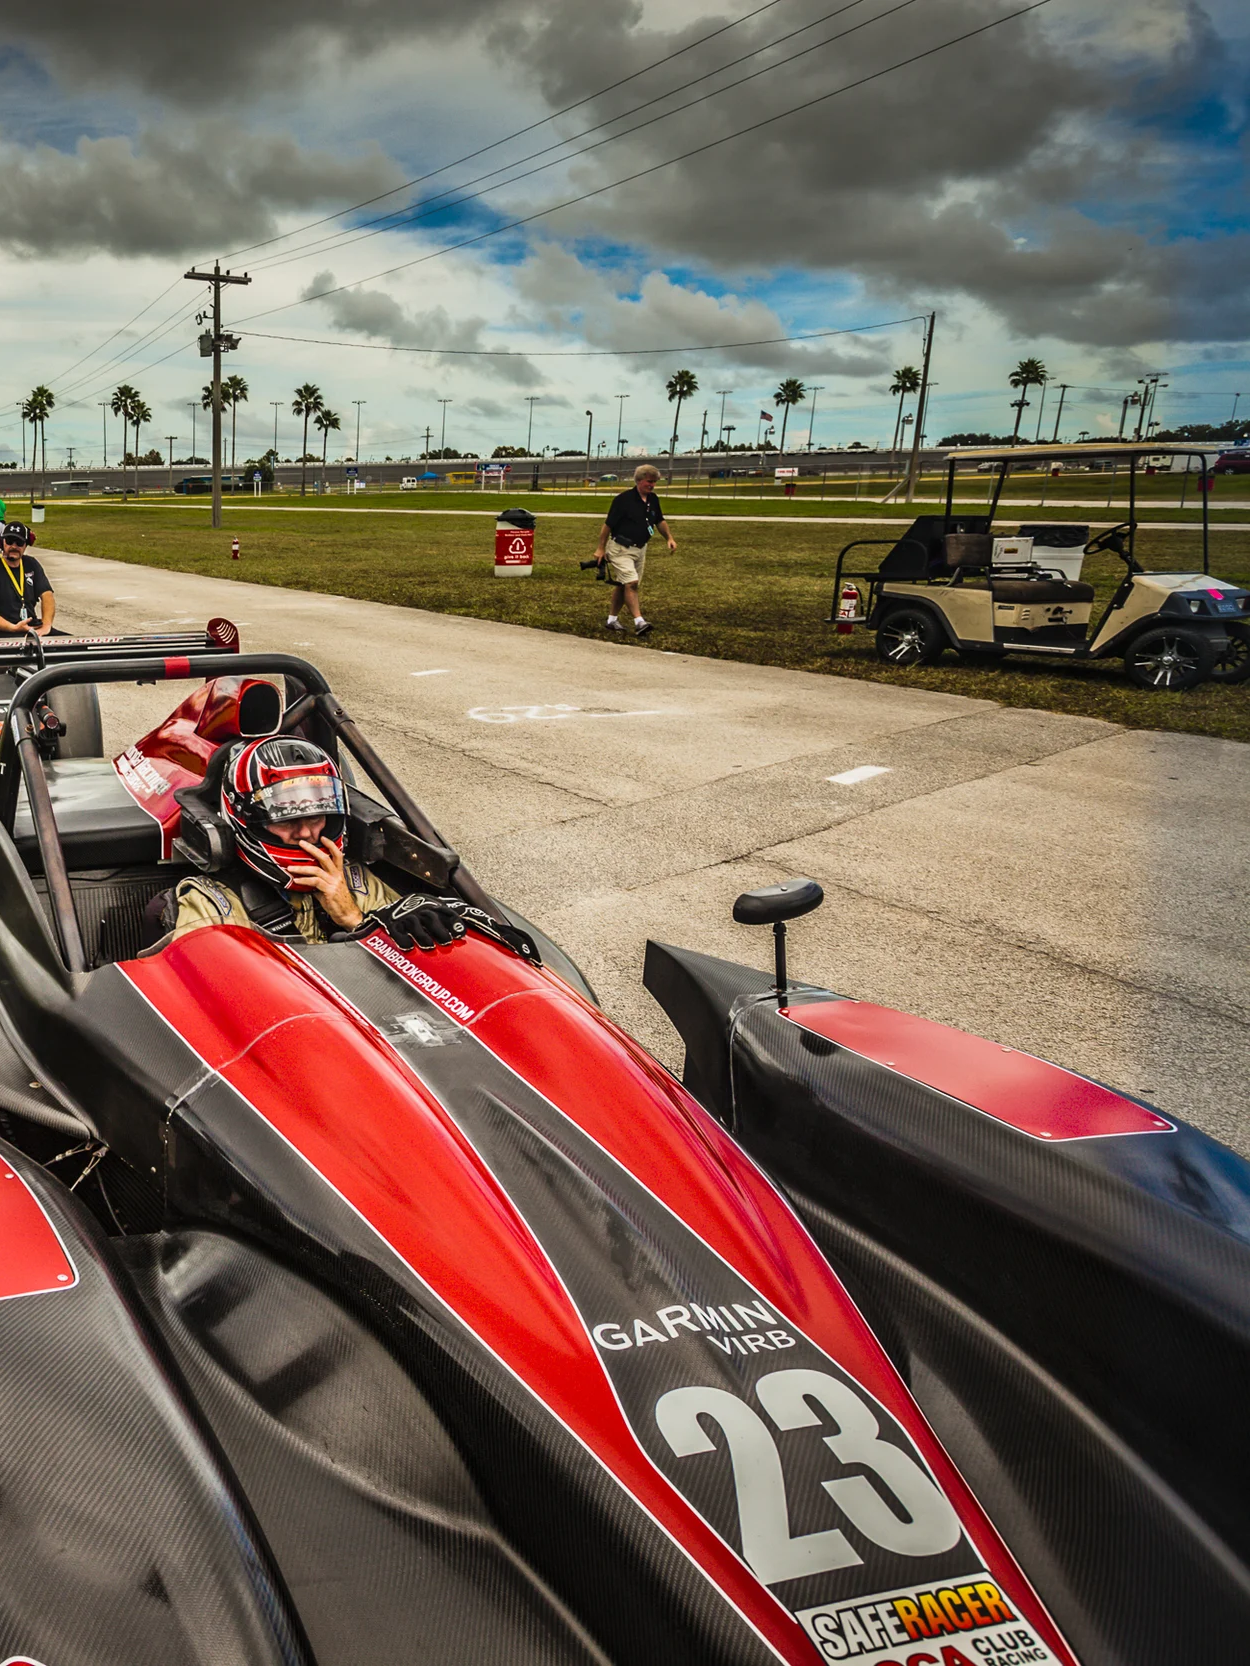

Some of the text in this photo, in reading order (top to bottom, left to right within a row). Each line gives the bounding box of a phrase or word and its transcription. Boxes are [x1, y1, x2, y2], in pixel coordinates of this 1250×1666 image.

[366, 936, 475, 1021] CRANBROOKGROUP.COM
[592, 1300, 777, 1350] GARMIN
[706, 1329, 796, 1355] VIRB
[655, 1369, 961, 1585] 23
[812, 1580, 1020, 1660] SAFERACER
[971, 1629, 1036, 1656] CLUB
